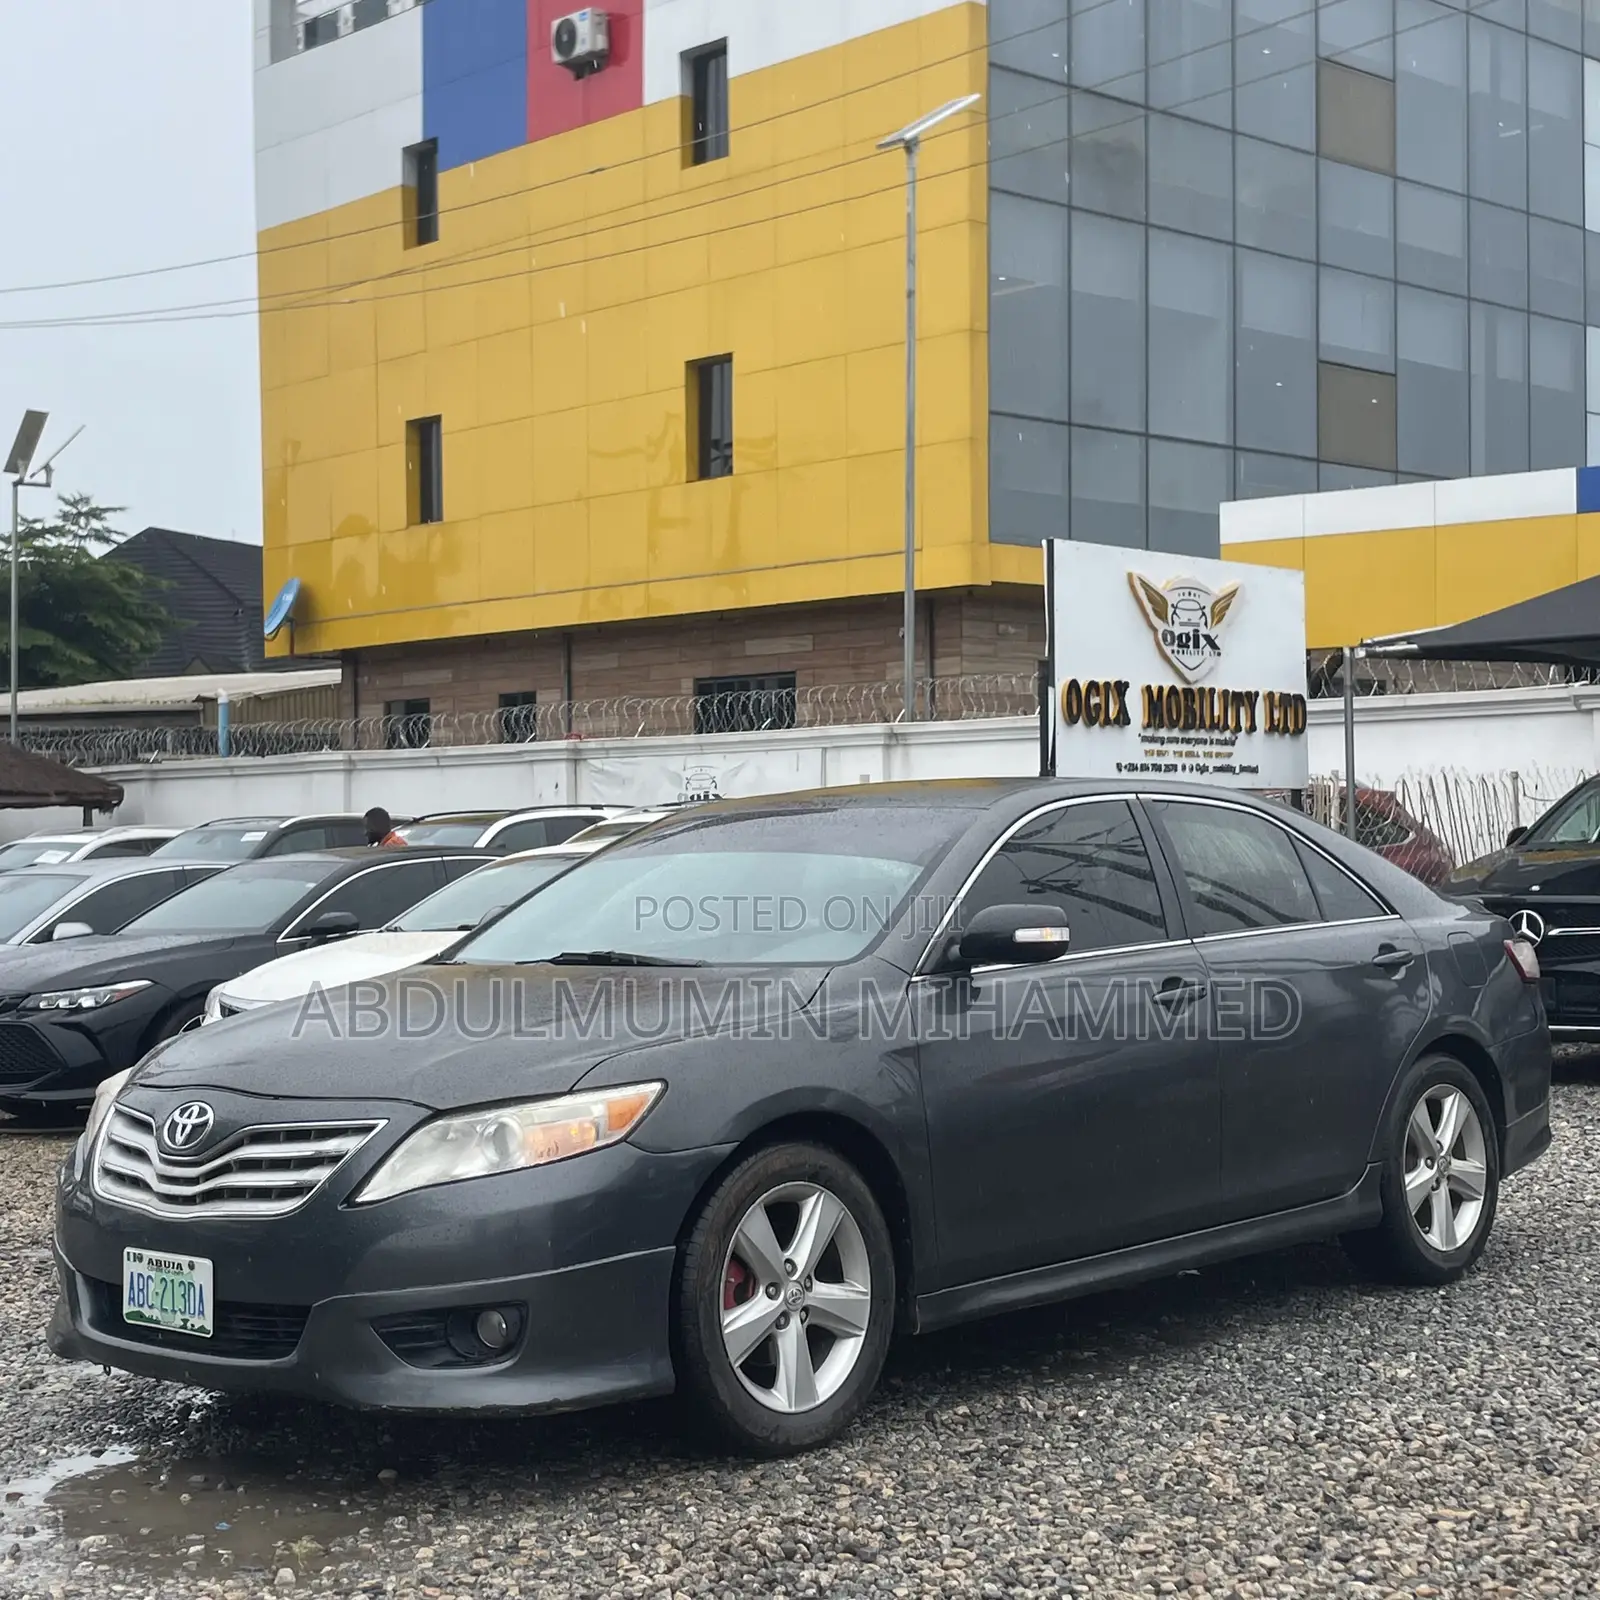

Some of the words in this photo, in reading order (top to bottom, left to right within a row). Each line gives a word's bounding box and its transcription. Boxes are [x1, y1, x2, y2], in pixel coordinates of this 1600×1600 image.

[1061, 678, 1131, 727] OGIX
[1141, 684, 1259, 733] MOBILITY
[1263, 690, 1307, 736] LTD
[147, 1257, 184, 1271] ABUJA
